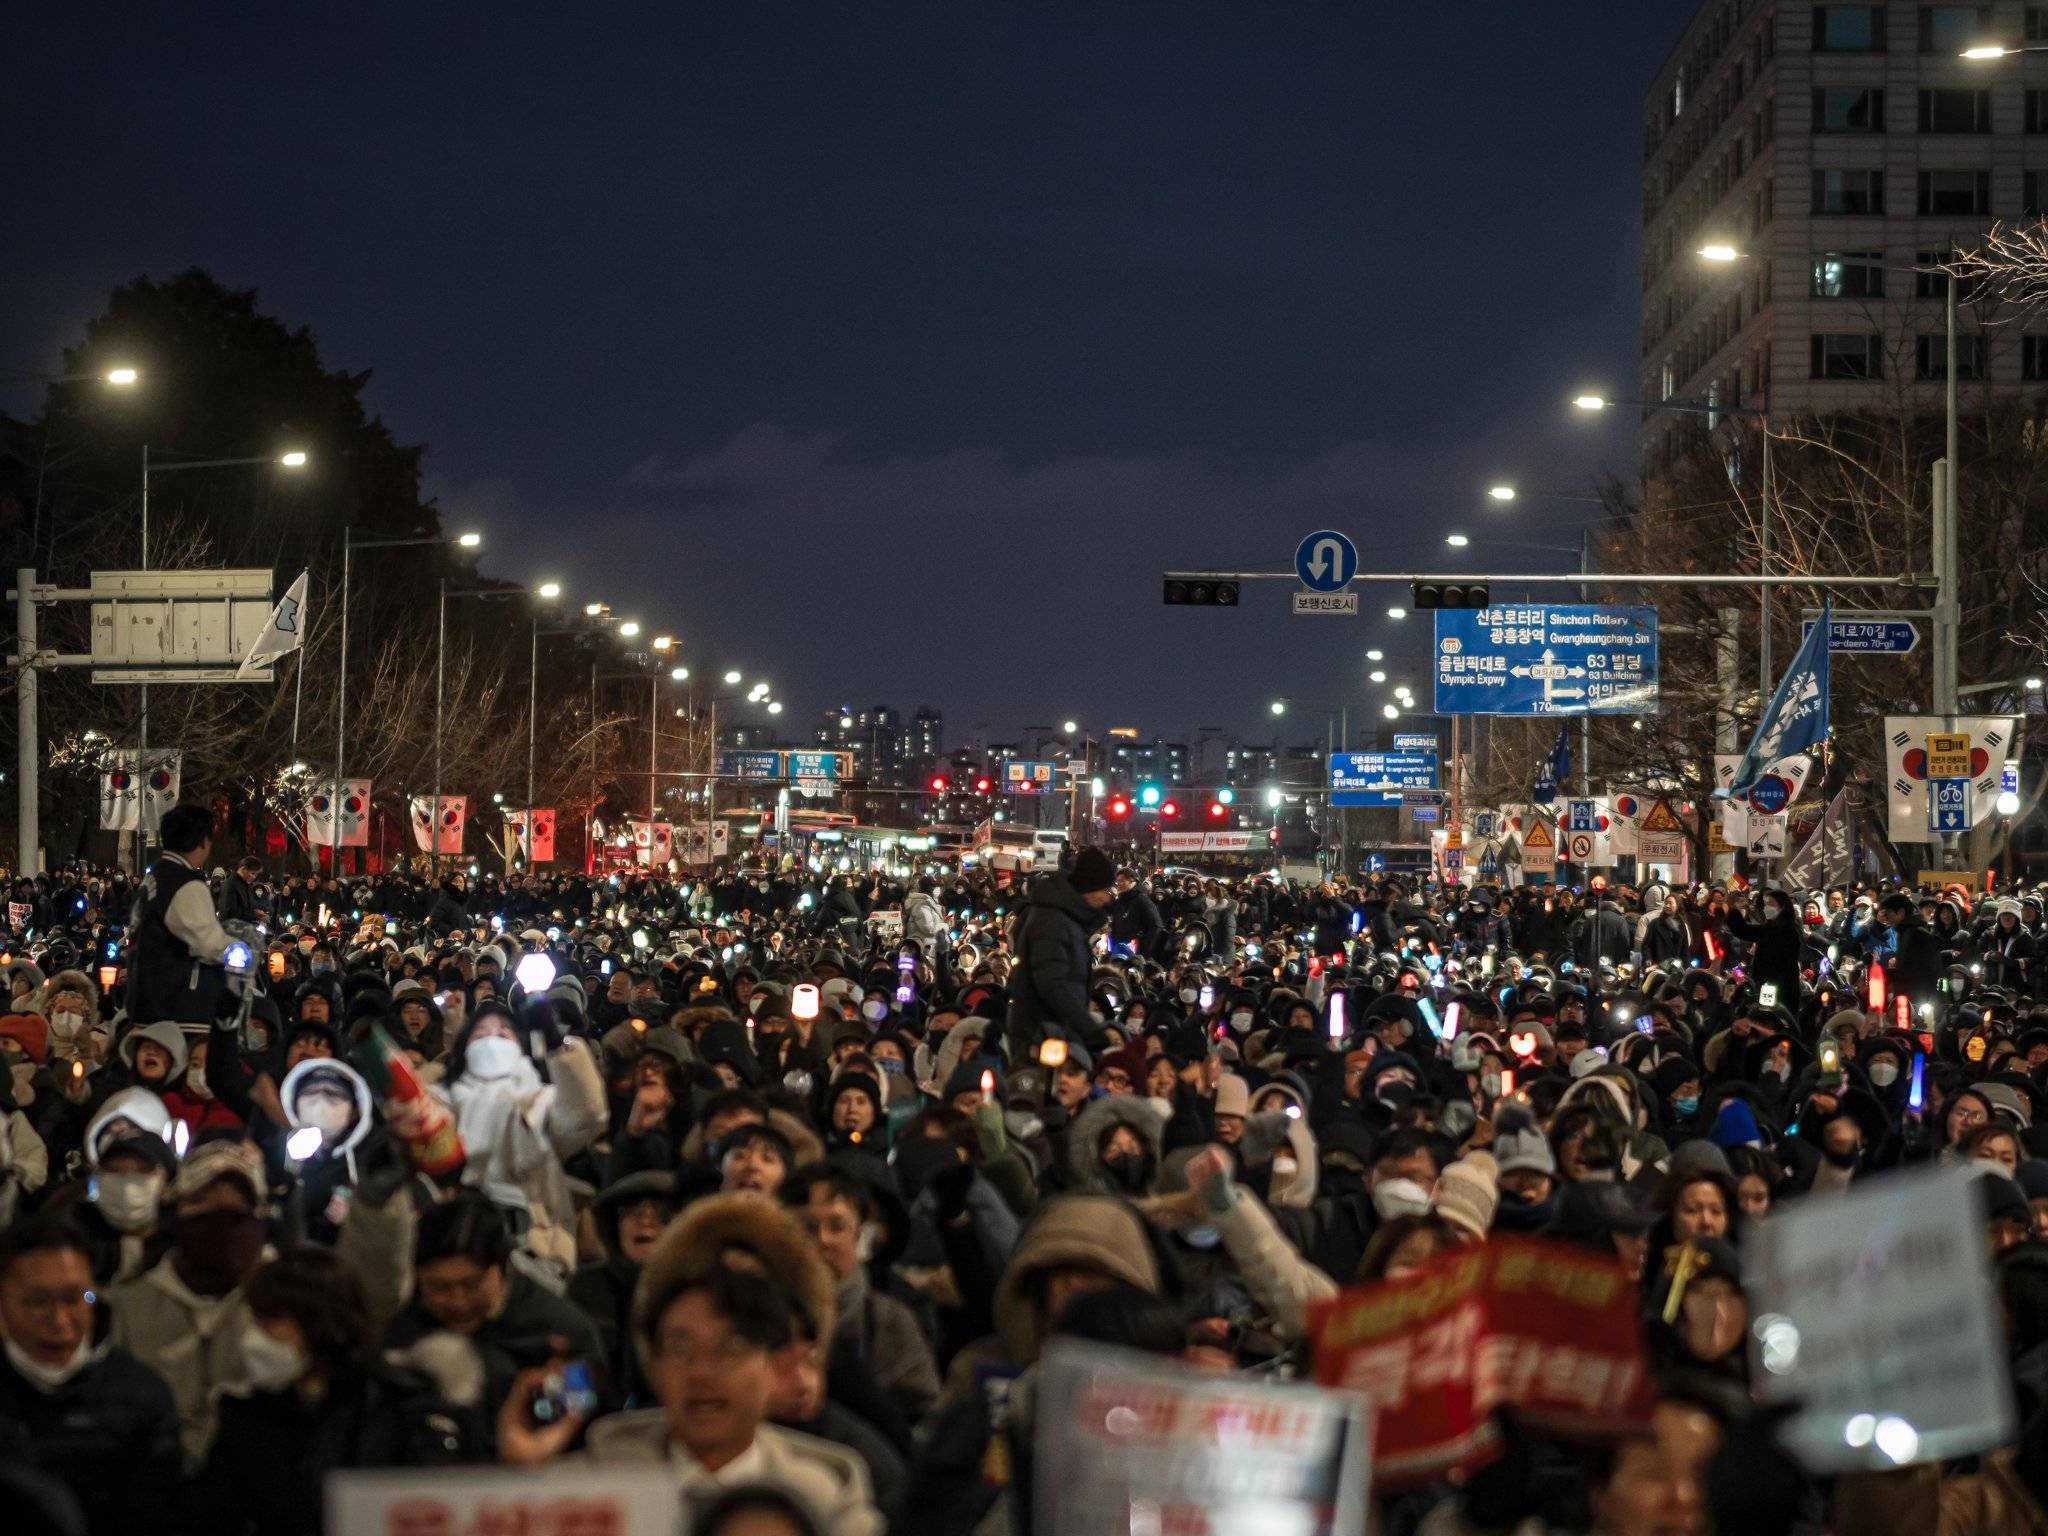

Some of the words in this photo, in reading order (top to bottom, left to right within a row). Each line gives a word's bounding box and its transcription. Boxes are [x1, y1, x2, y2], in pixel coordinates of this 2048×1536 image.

[1297, 598, 1354, 610] 보행신호시
[1476, 609, 1545, 626] 신촌로터리
[1549, 613, 1590, 625] Sinchon
[1593, 614, 1628, 626] Rotary
[1489, 627, 1545, 644] 광흥창역
[1549, 632, 1633, 646] Gwangheungchang
[1439, 655, 1507, 673] 올림픽대로
[1587, 654, 1606, 668] 63
[1612, 654, 1641, 670] 빌딩
[1440, 673, 1475, 686] Olympic
[1477, 674, 1506, 686] Expwy
[1588, 671, 1600, 680] 63
